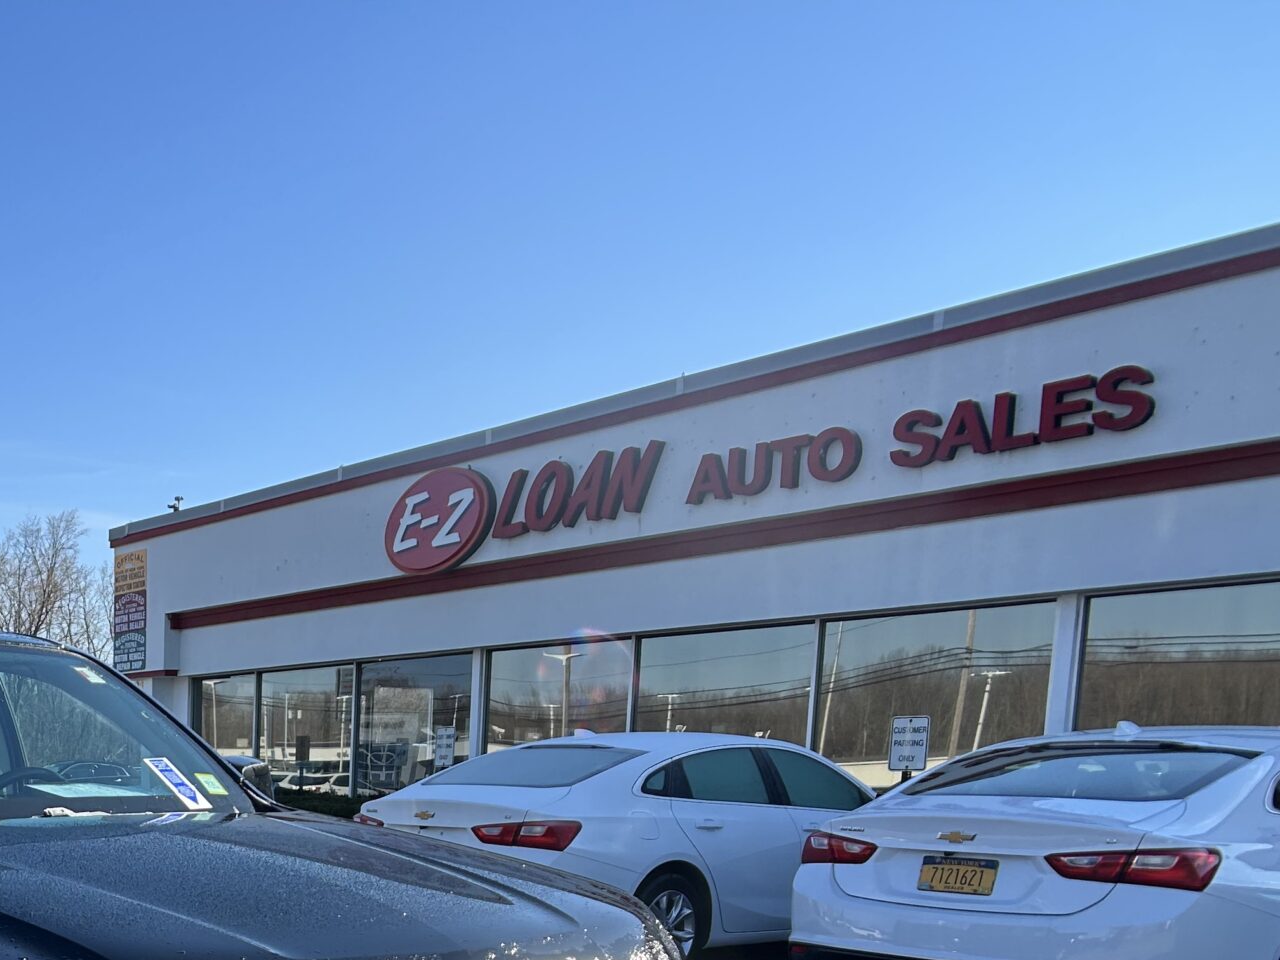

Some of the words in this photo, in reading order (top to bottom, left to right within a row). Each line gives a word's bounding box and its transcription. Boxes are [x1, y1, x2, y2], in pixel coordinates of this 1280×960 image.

[393, 487, 475, 553] E-Z
[492, 439, 666, 539] LOAN
[685, 426, 863, 505] AUTO
[889, 365, 1156, 468] SALES
[116, 552, 145, 569] OFFICIAL
[116, 593, 145, 610] REGISTERED
[116, 632, 145, 648] REGISTERED
[893, 726, 927, 734] CUSOMER
[898, 754, 915, 762] ONLY
[930, 866, 985, 887] 7121621
